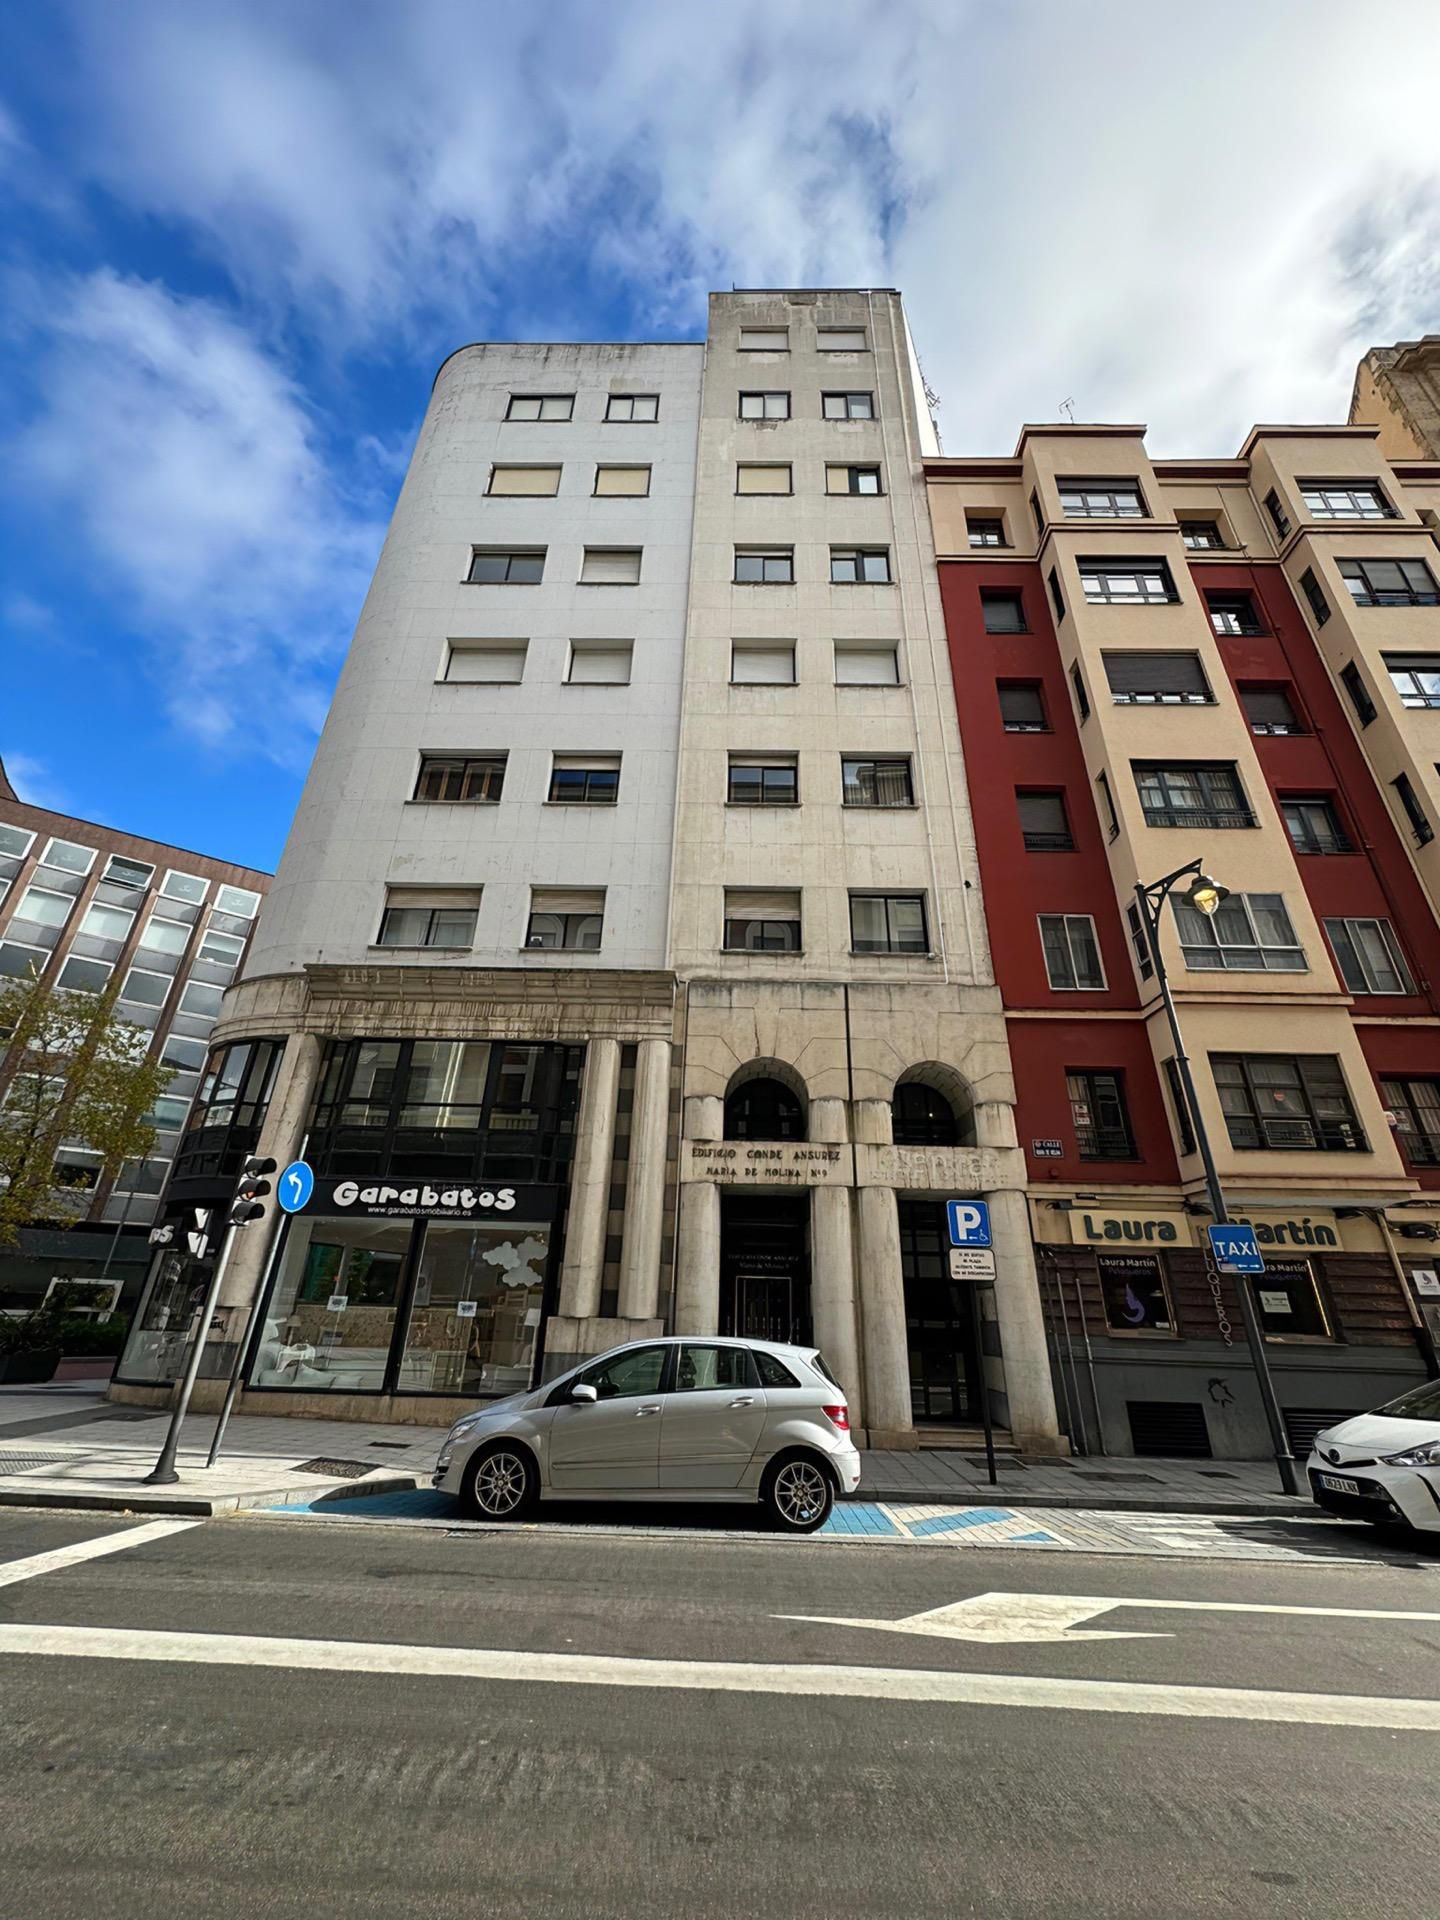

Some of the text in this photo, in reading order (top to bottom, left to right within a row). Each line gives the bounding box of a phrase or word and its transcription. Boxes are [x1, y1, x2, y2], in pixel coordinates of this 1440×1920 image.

[692, 1148, 841, 1161] EDIFICIO CONDE ANSUREZ
[706, 1167, 737, 1176] MARIA
[744, 1168, 758, 1177] DE
[764, 1168, 802, 1177] MOLINA
[333, 1181, 516, 1211] Garabatos
[367, 1206, 472, 1217] www.garabatosmobiliario.es
[956, 1206, 981, 1240] P
[1083, 1214, 1177, 1241] Laura
[1215, 1241, 1258, 1256] TAXI
[1099, 1257, 1125, 1267] Laura
